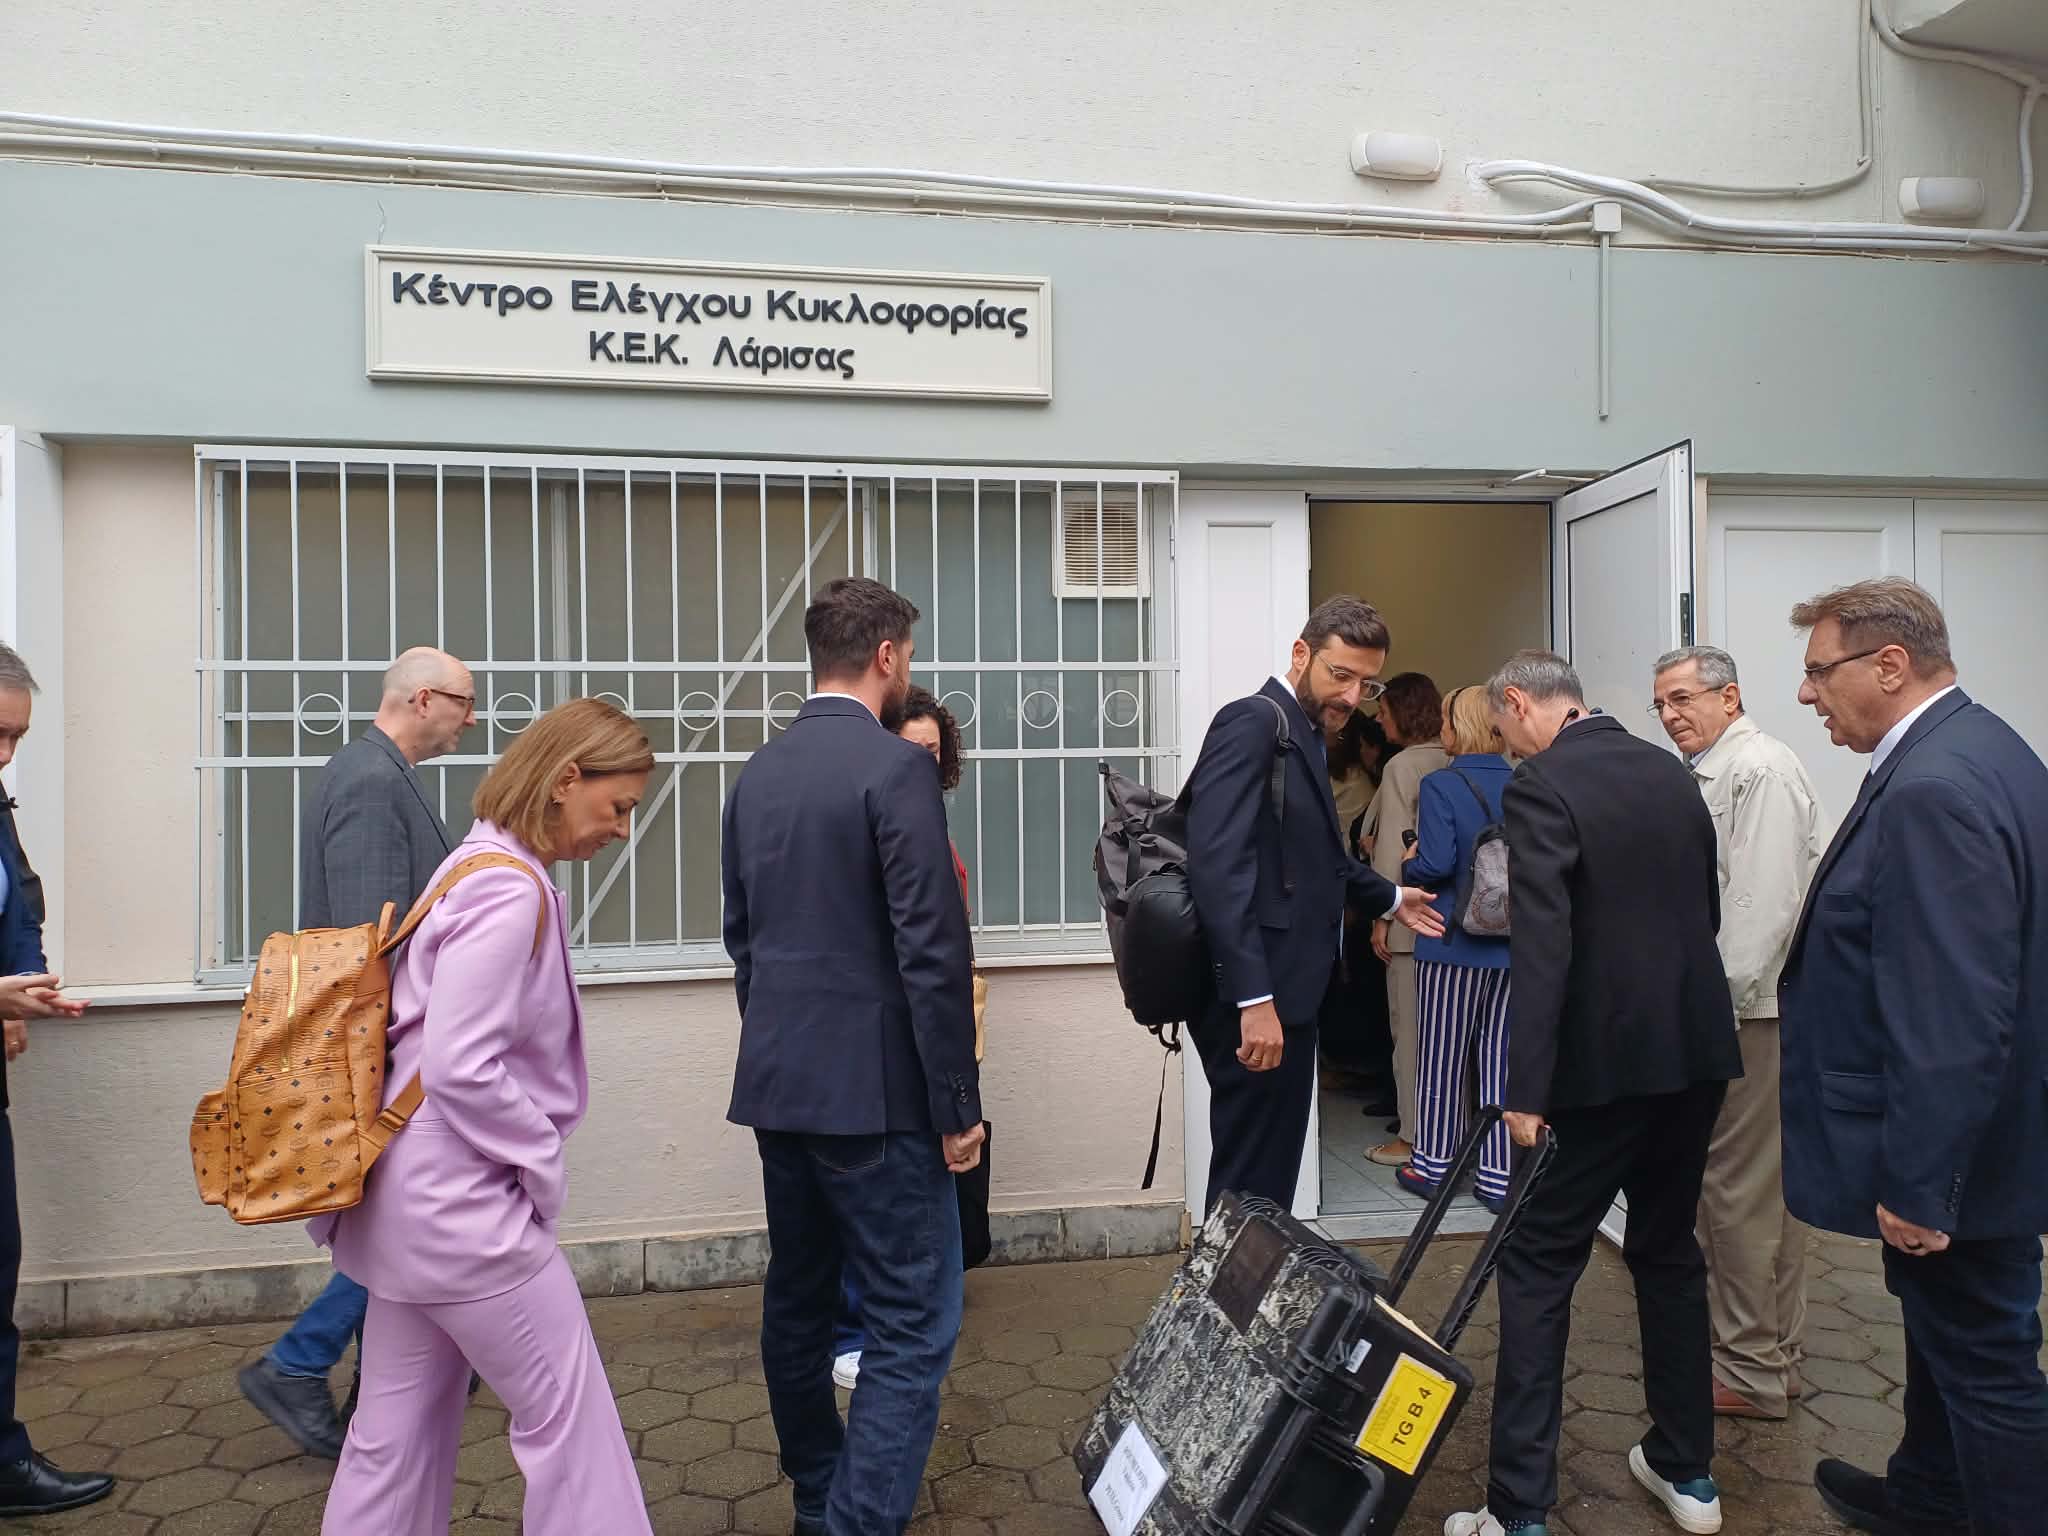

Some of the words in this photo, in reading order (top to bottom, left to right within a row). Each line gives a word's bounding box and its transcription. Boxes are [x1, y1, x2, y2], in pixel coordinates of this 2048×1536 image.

[392, 271, 553, 318] Κέντρο
[571, 279, 752, 325] Ελέγχου
[767, 289, 1028, 339] Κυκλοφορίας
[712, 335, 855, 380] Λάρισας
[1391, 1420, 1415, 1447] TG
